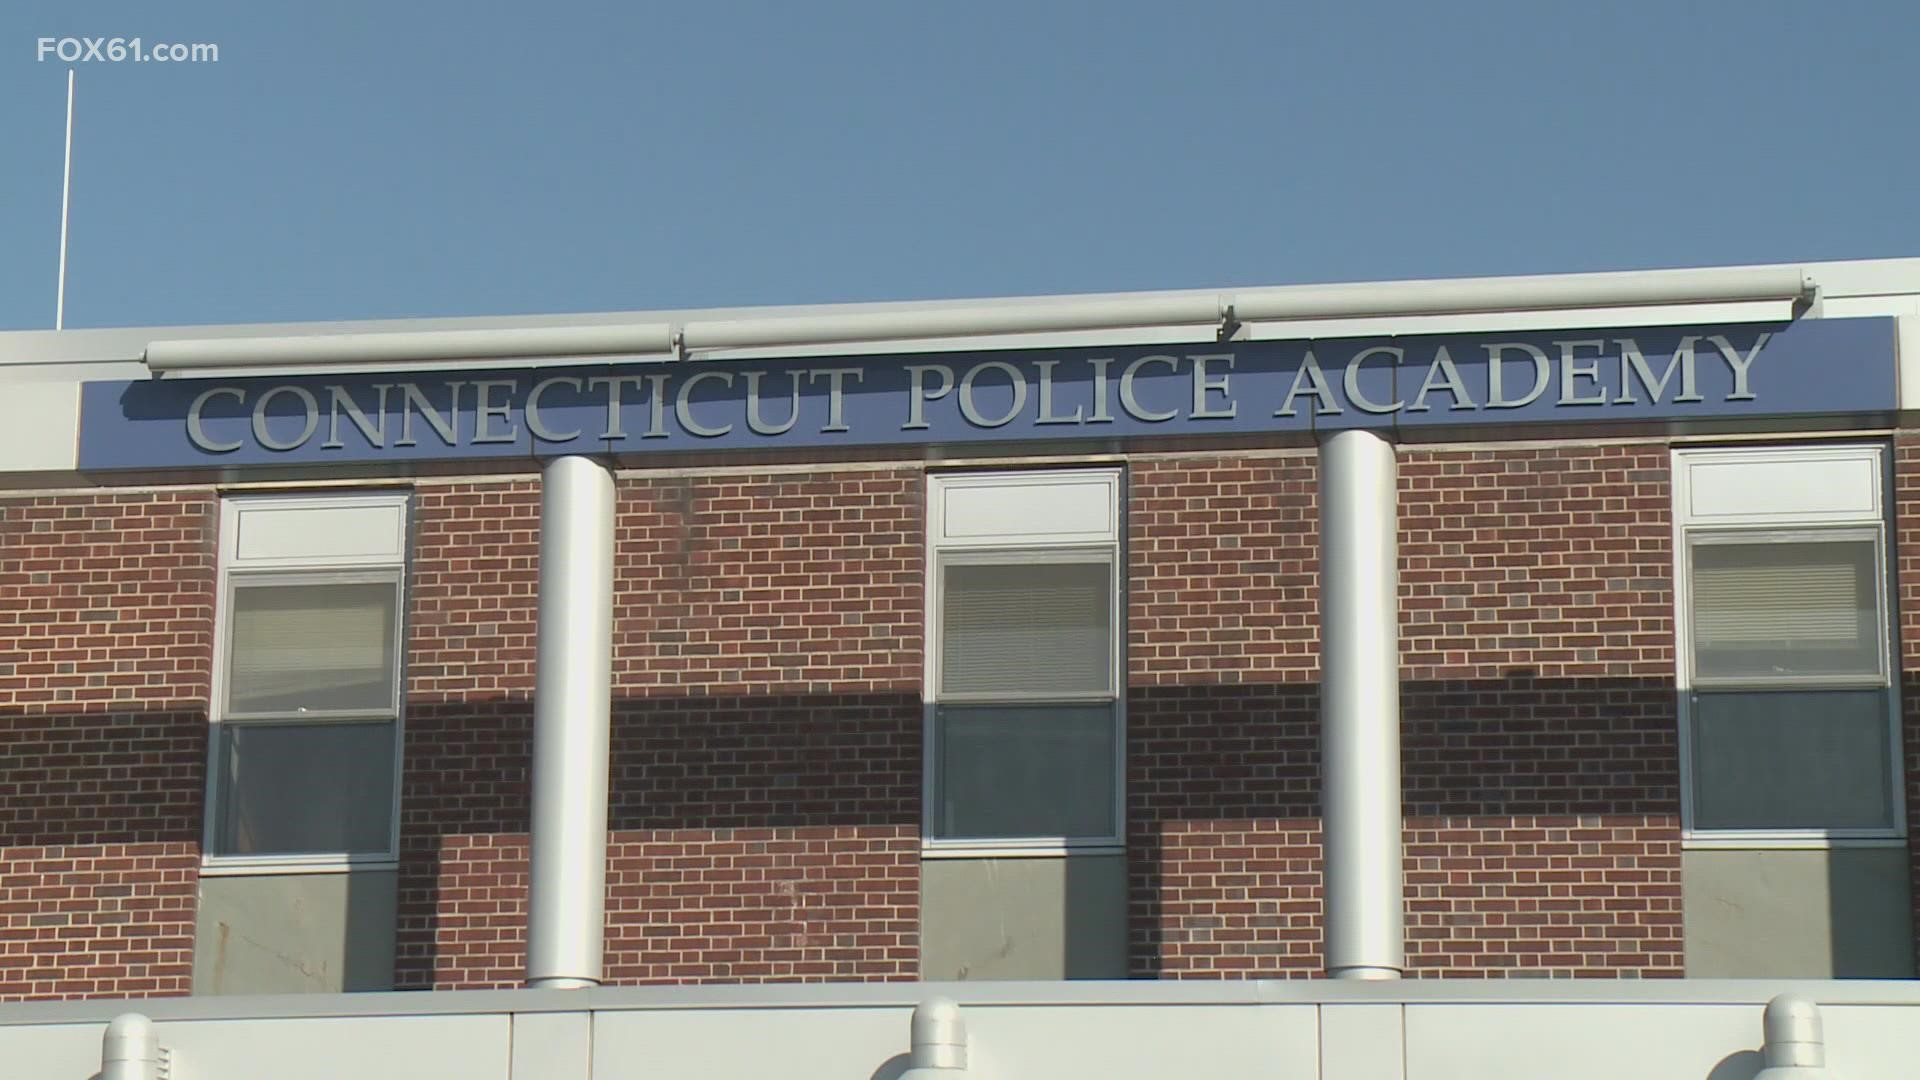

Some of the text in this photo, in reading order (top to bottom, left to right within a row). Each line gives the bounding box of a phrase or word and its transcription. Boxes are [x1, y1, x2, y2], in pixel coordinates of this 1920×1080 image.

[186, 332, 1771, 452] CONNECTICUT POLICE ACADEMY
